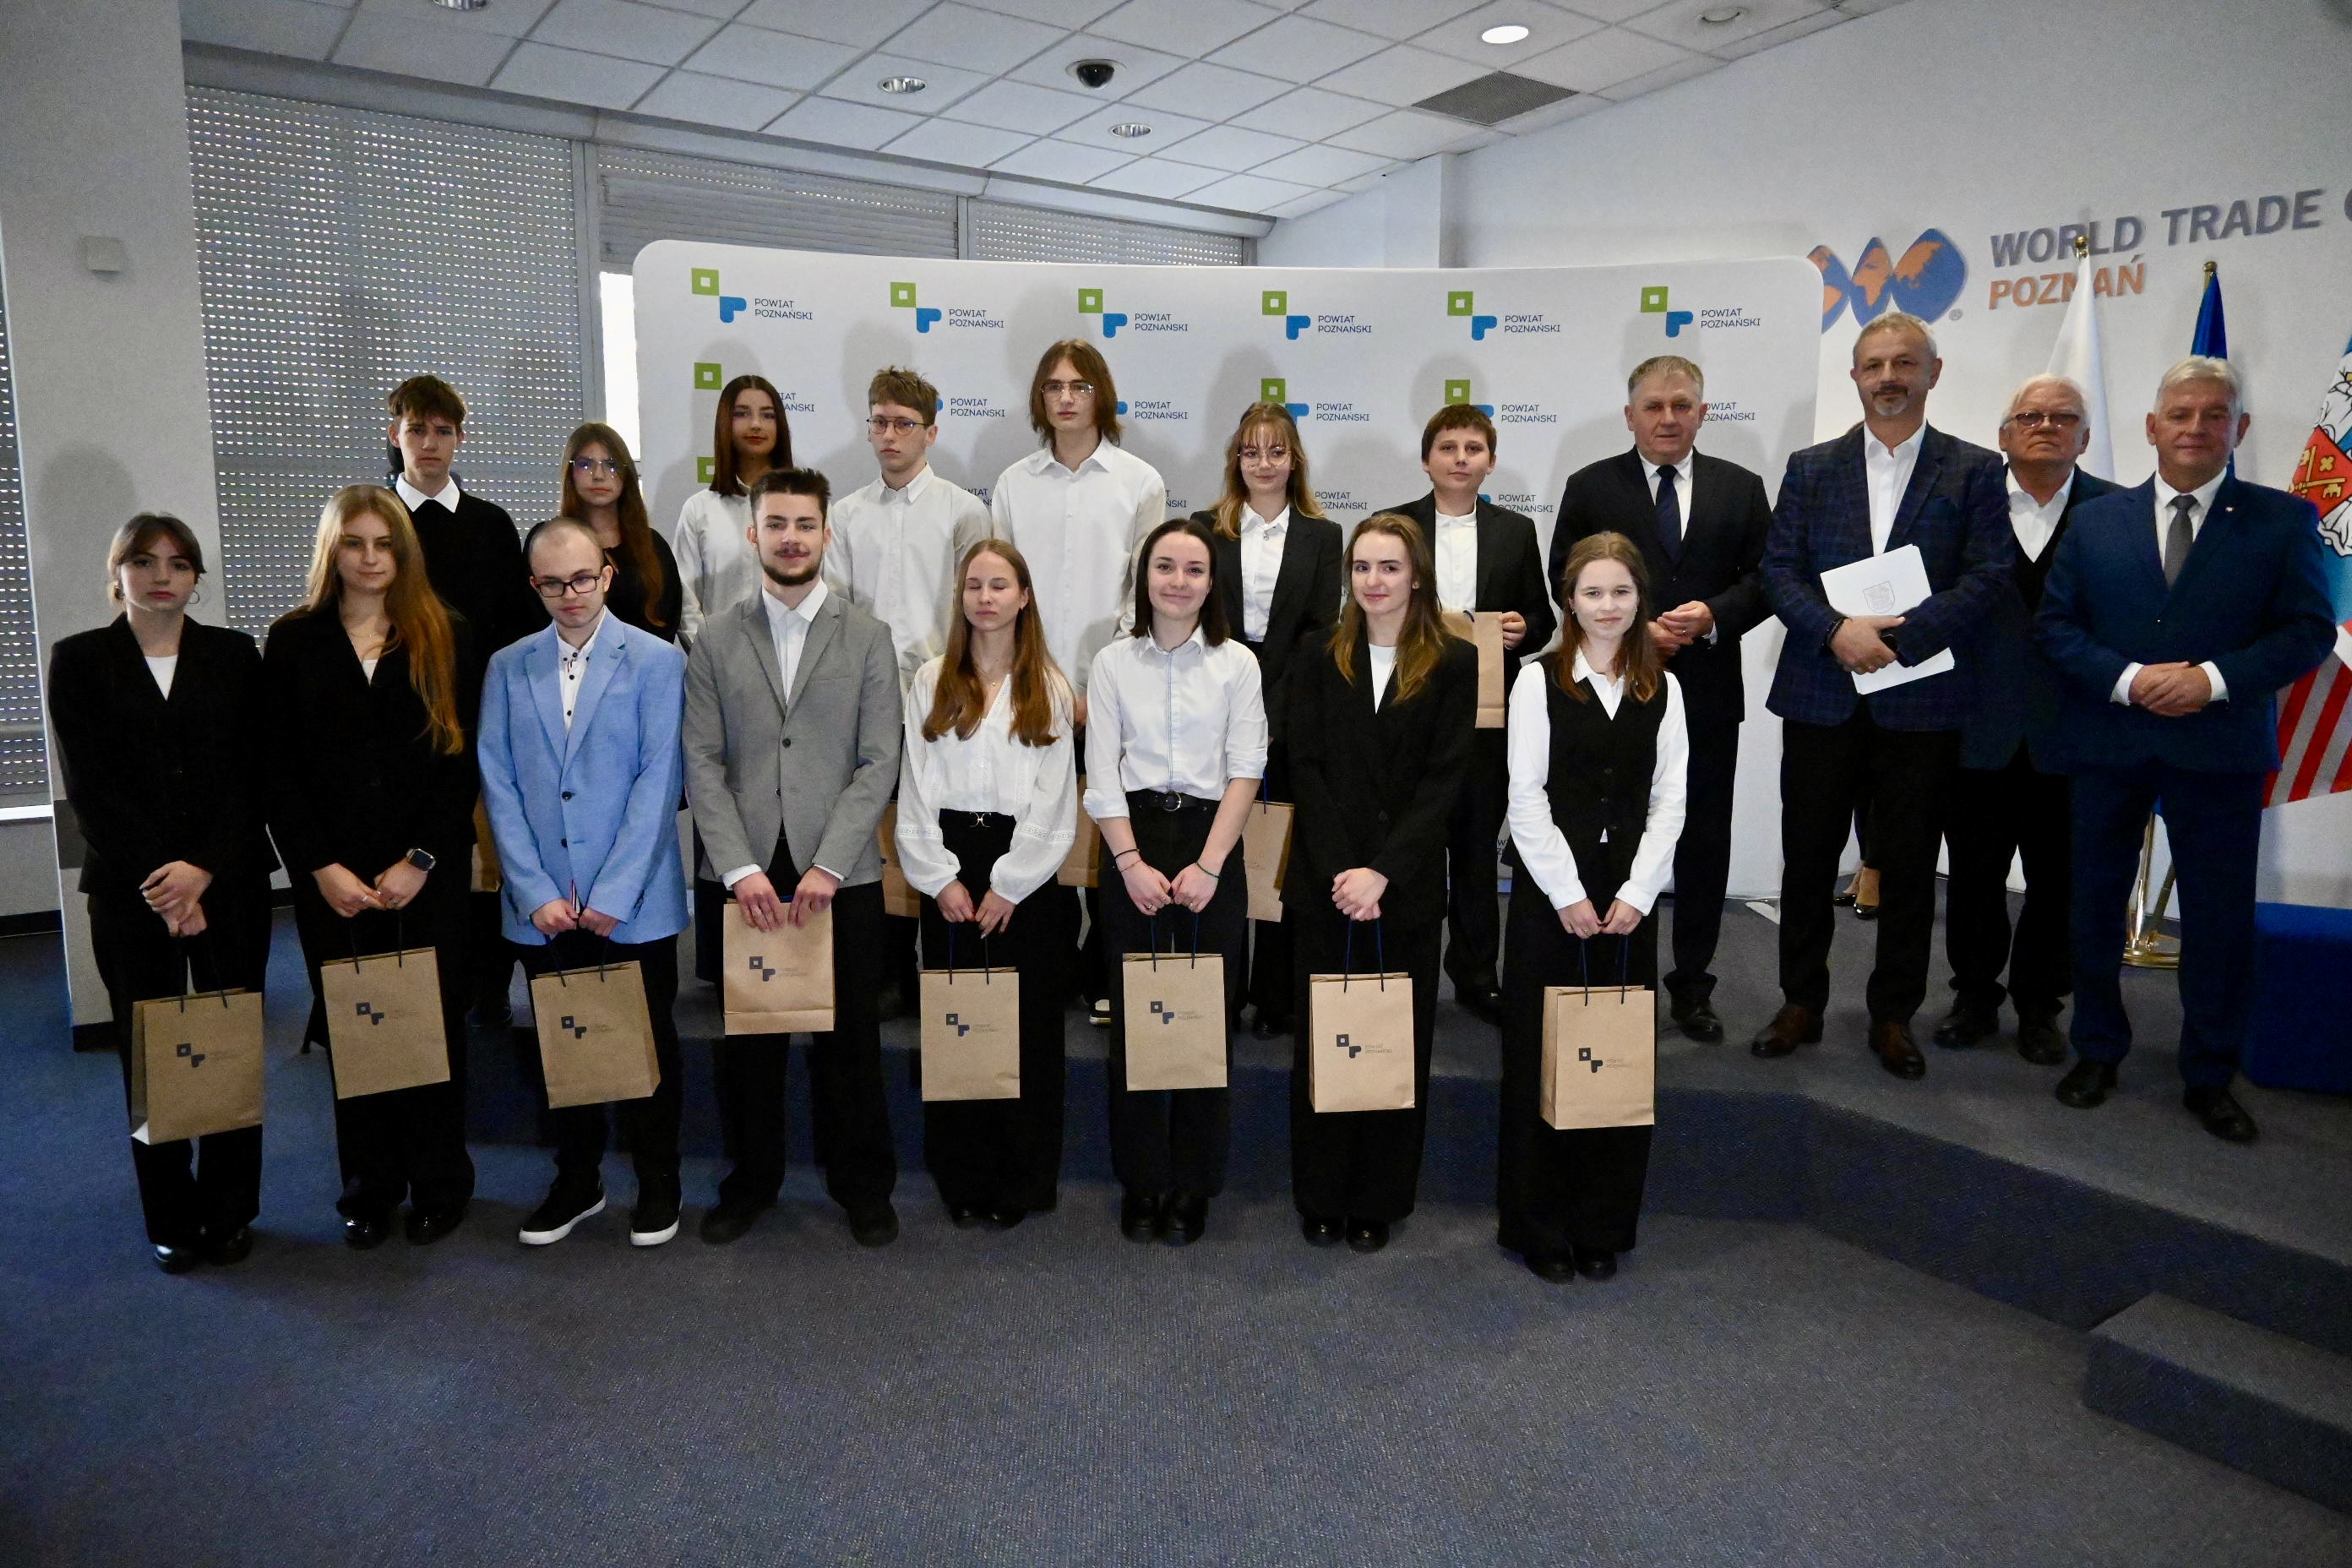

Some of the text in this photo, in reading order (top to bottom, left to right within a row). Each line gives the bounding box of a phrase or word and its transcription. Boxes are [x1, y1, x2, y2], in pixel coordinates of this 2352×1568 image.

[1990, 216, 2147, 268] WORLD
[2160, 188, 2325, 246] TRADE
[754, 298, 795, 308] POWIAT
[754, 308, 813, 320] POZNAŃSKI
[949, 308, 987, 318] POWIAT
[1701, 308, 1742, 317] POWIAT
[949, 318, 1004, 329] POZNAŃSKI
[1135, 323, 1189, 331] POZNAŃSKI
[1318, 324, 1372, 333] POZNAŃSKI
[1505, 324, 1560, 333] POZNAŃSKI
[1701, 318, 1761, 329] POZNAŃSKI
[780, 392, 797, 400] IAT
[785, 401, 815, 412] AŃSKI
[950, 398, 988, 406] POWIAT
[1316, 403, 1353, 411] POWIAT
[1706, 401, 1737, 411] OWIAT
[950, 407, 1005, 417] POZNAŃSKI
[1501, 404, 1539, 412] POWIAT
[1135, 410, 1189, 420] POZNAŃSKI
[1316, 412, 1370, 422] POZNAŃSKI
[1501, 413, 1557, 422] POZNAŃSKI
[1703, 411, 1756, 422] OZNAŃSKI
[1315, 492, 1351, 500] POWIAT
[1499, 494, 1537, 503] POWIAT
[1320, 500, 1369, 510] OZNAŃSKI
